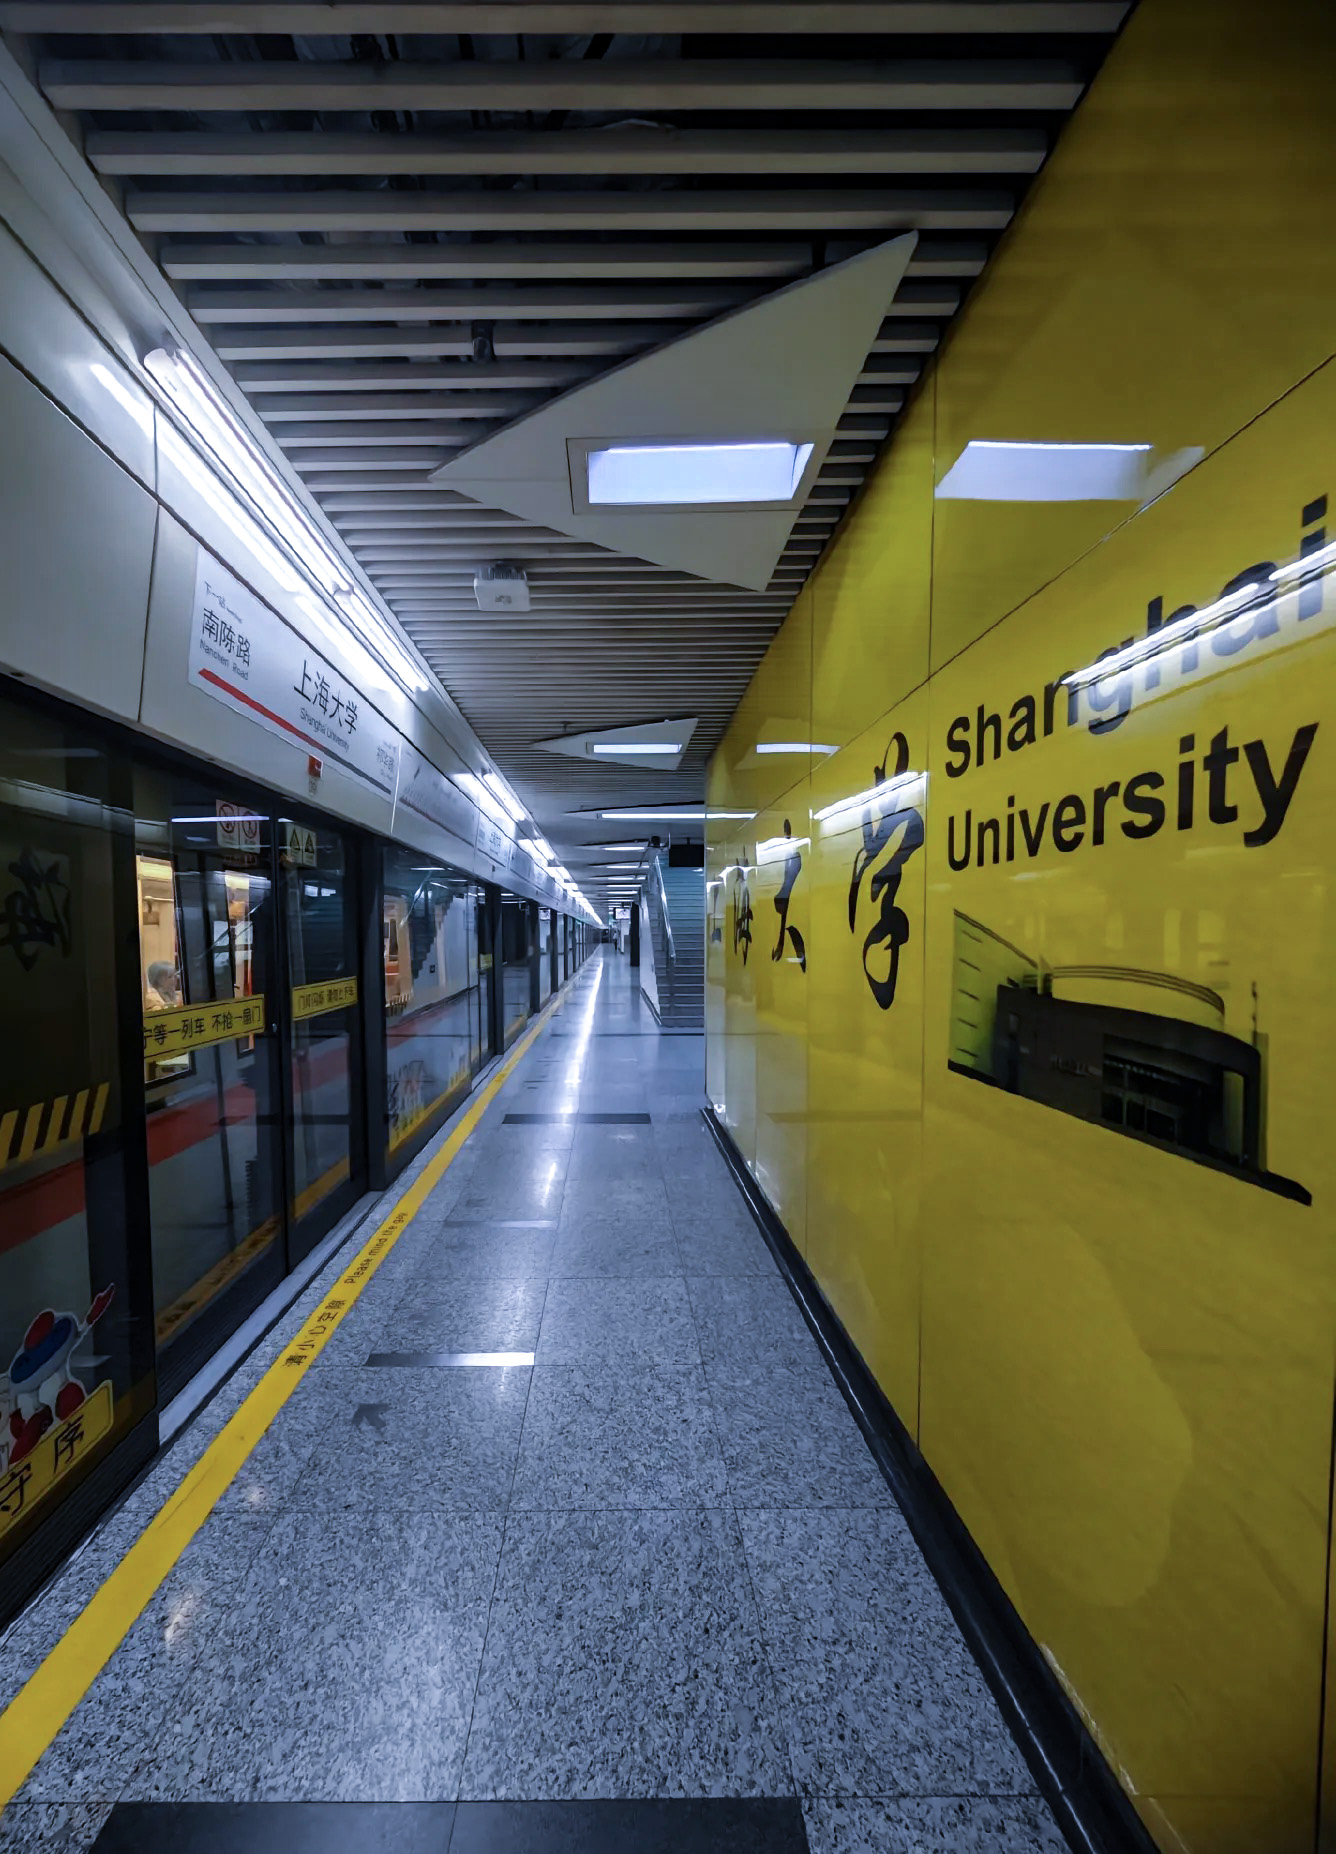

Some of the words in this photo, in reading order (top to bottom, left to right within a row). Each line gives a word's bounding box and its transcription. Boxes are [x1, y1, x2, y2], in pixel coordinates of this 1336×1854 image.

[202, 607, 250, 667] 南陈路
[944, 493, 1328, 779] Shanghai
[293, 660, 358, 734] 上海大学
[947, 721, 1320, 872] University
[344, 1258, 373, 1284] Please
